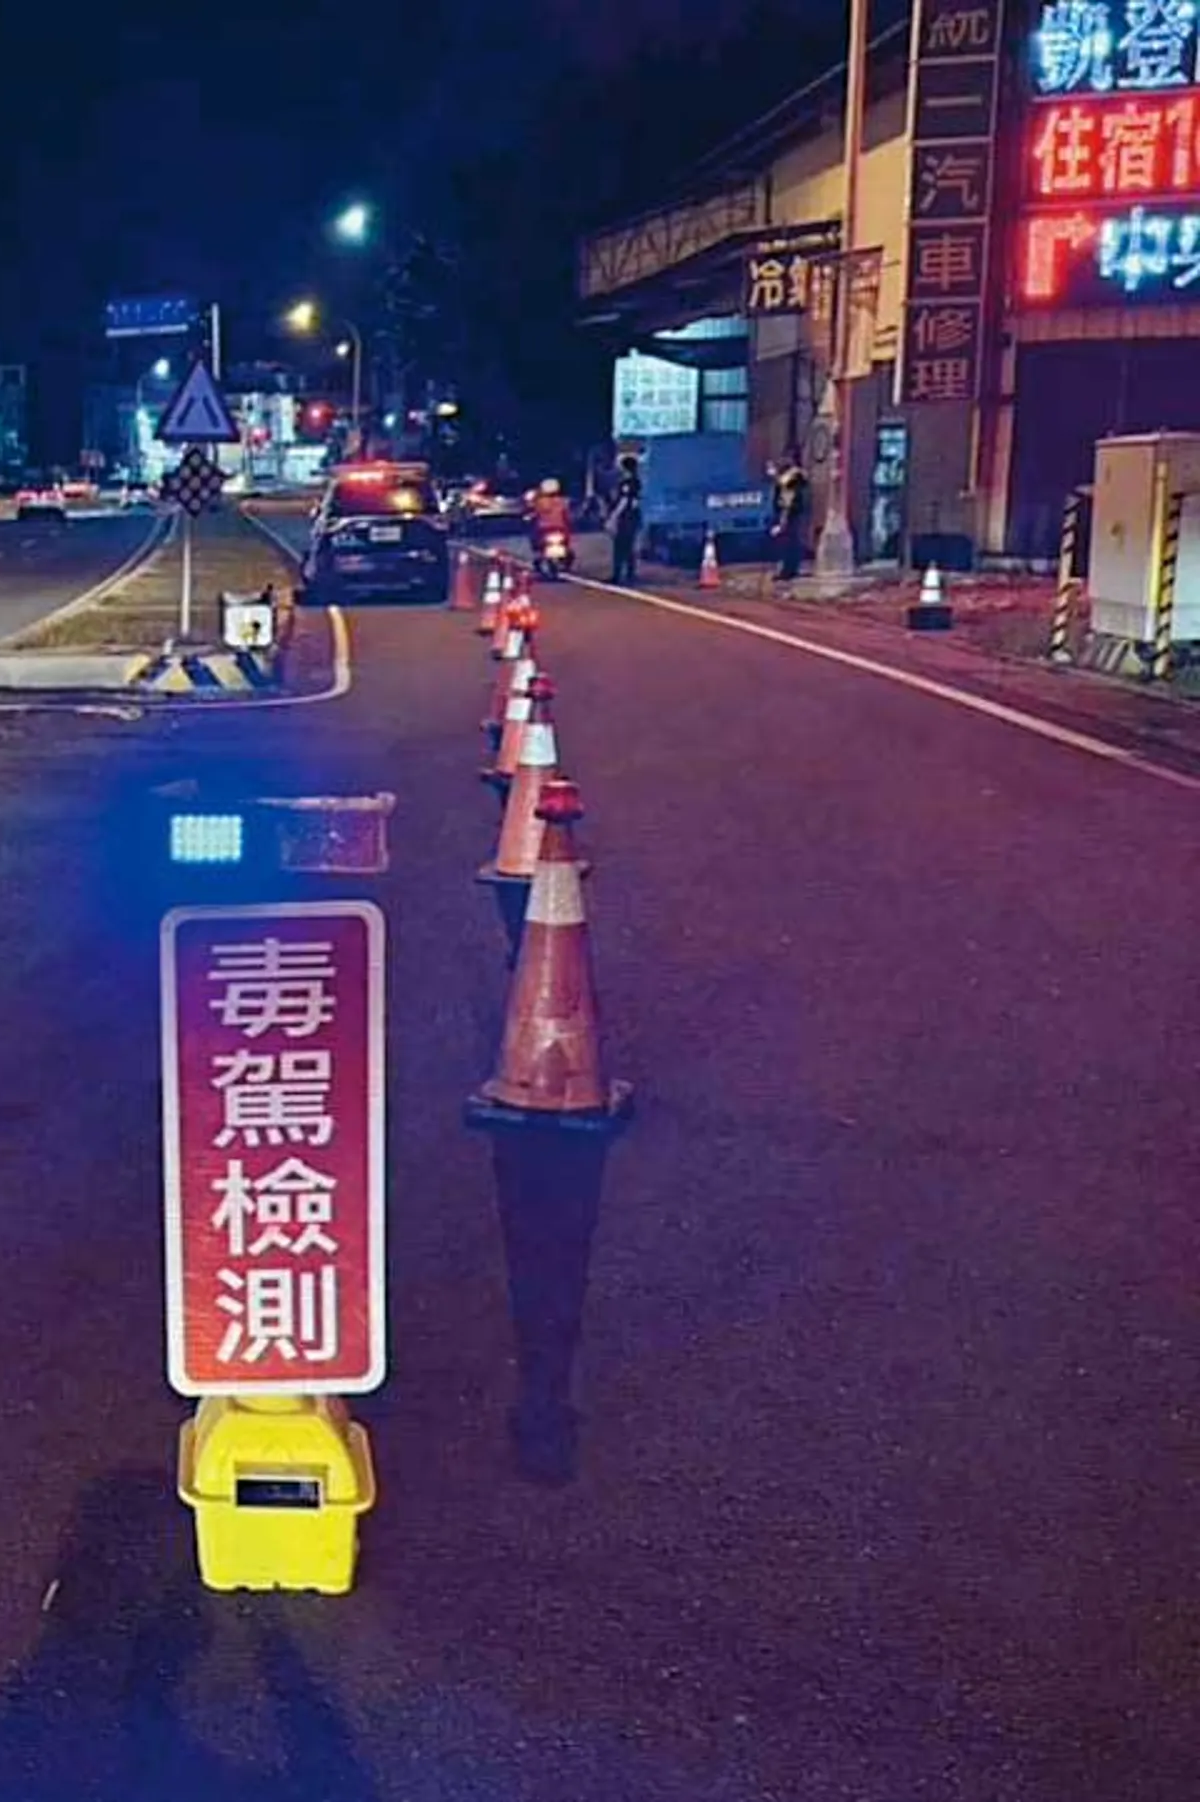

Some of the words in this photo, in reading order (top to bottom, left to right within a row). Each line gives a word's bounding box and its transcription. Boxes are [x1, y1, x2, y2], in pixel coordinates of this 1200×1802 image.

[1036, 0, 1200, 91] 凱登
[1032, 97, 1200, 194] 住宿1
[207, 937, 339, 1363] 毒駕檢測
